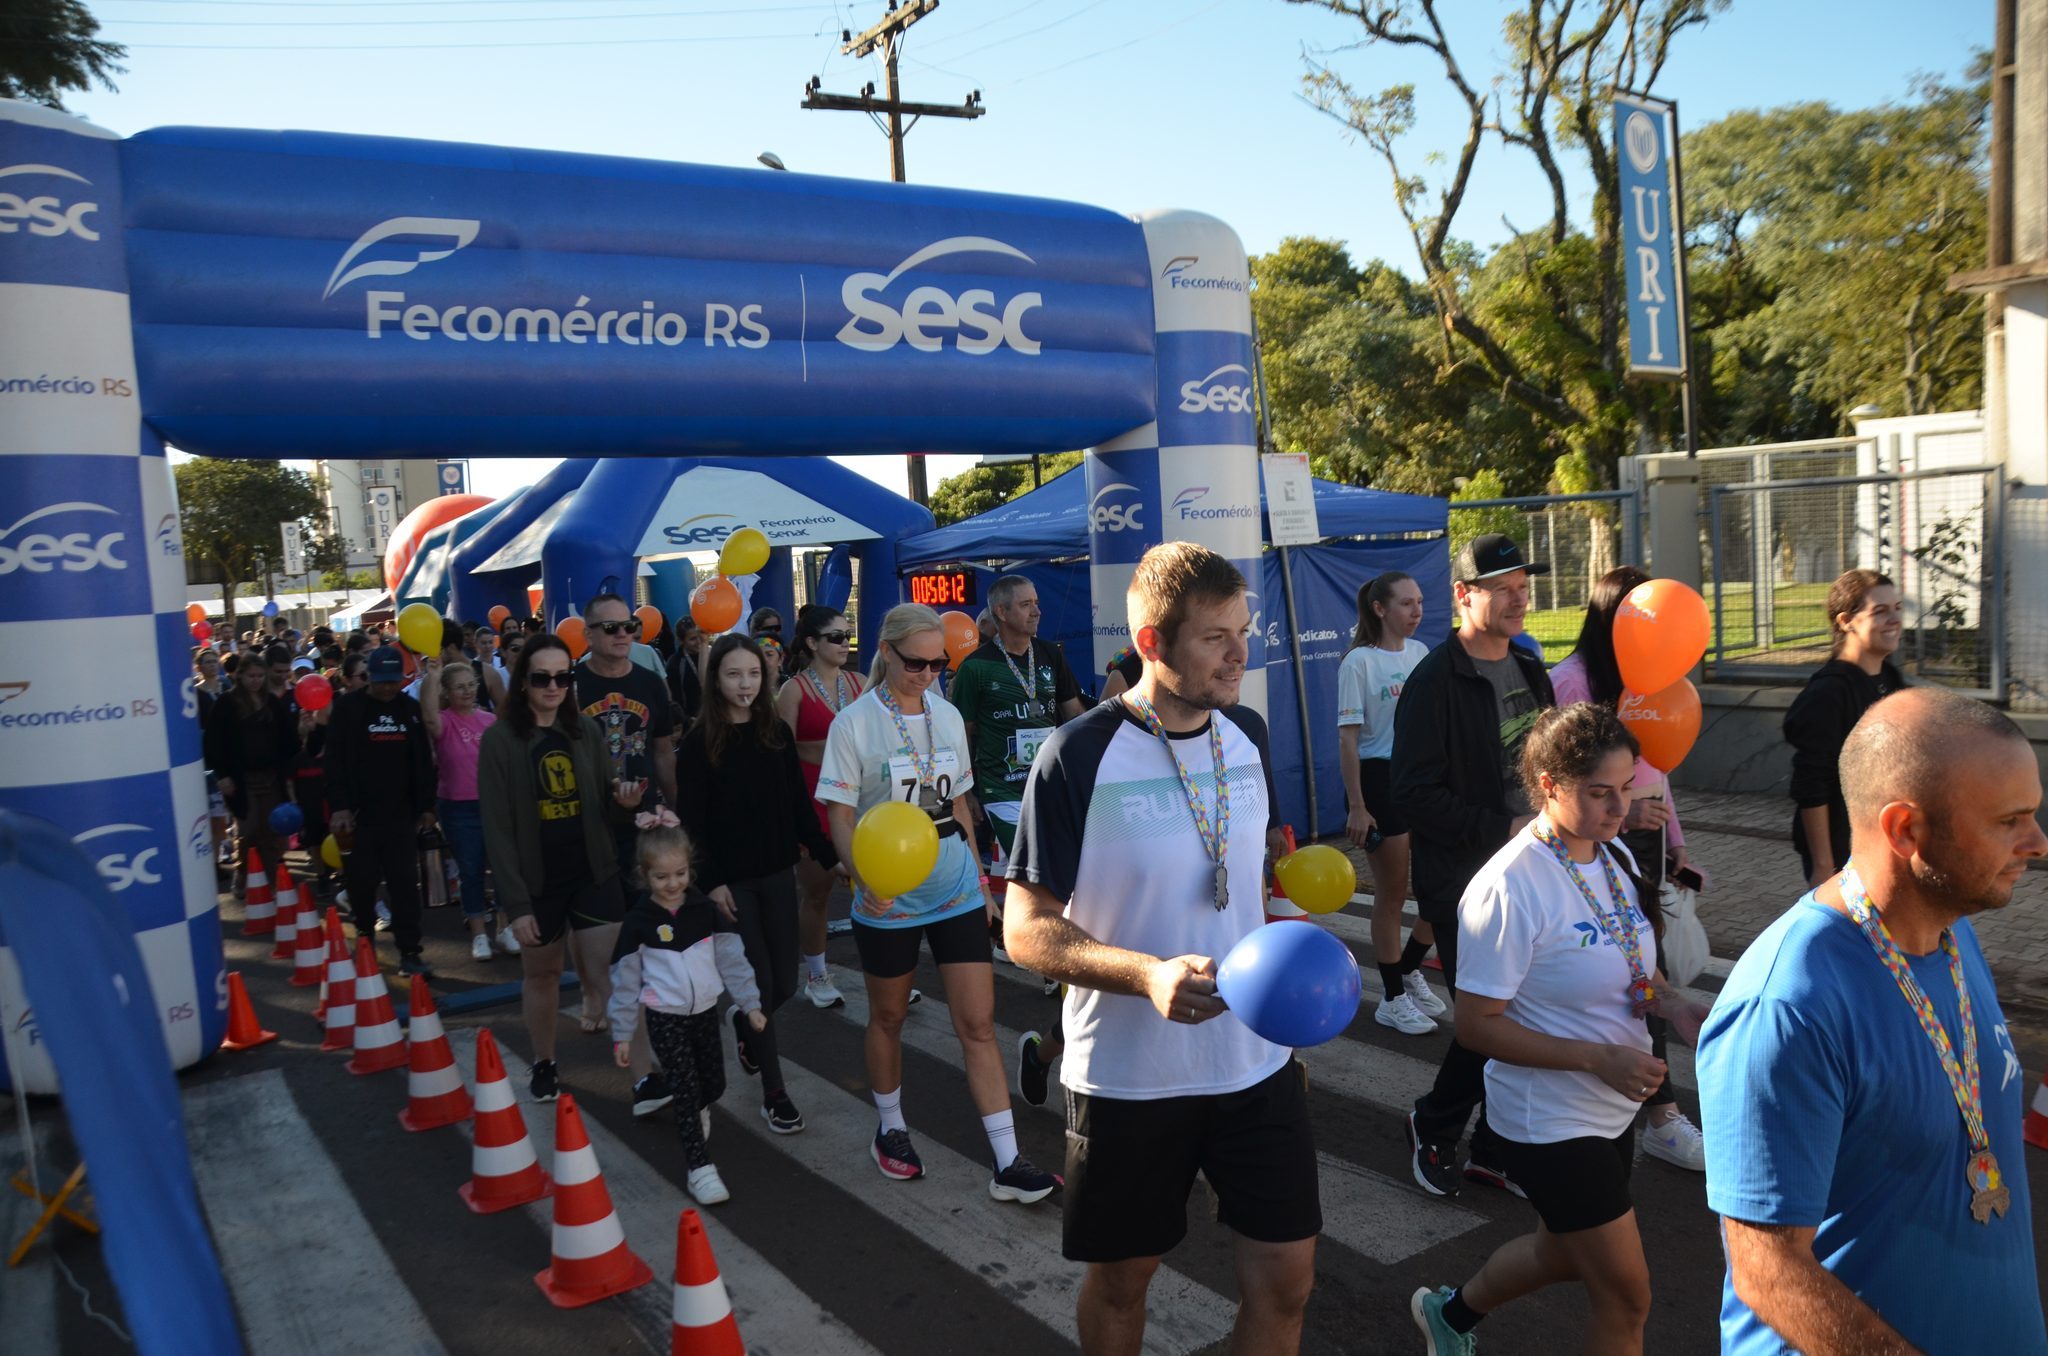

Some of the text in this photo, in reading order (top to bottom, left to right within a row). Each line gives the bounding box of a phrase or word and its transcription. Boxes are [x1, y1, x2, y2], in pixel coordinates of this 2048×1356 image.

[1171, 275, 1241, 292] Fecomércio
[1632, 186, 1665, 361] URI
[366, 290, 770, 349] Fecomércio RS
[835, 270, 1042, 355] Sesc
[103, 378, 131, 397] RS
[1179, 380, 1251, 413] Sesc
[759, 516, 836, 528] Fecomércio
[1181, 505, 1251, 520] Fecomércio
[663, 523, 747, 545] Ses
[286, 539, 298, 571] URI
[911, 574, 966, 605] 00:58:12
[1297, 629, 1338, 643] ndicatos
[0, 699, 158, 729] ecomércio RS
[901, 773, 951, 804] 70
[96, 846, 163, 892] sc
[168, 1002, 194, 1023] RS
